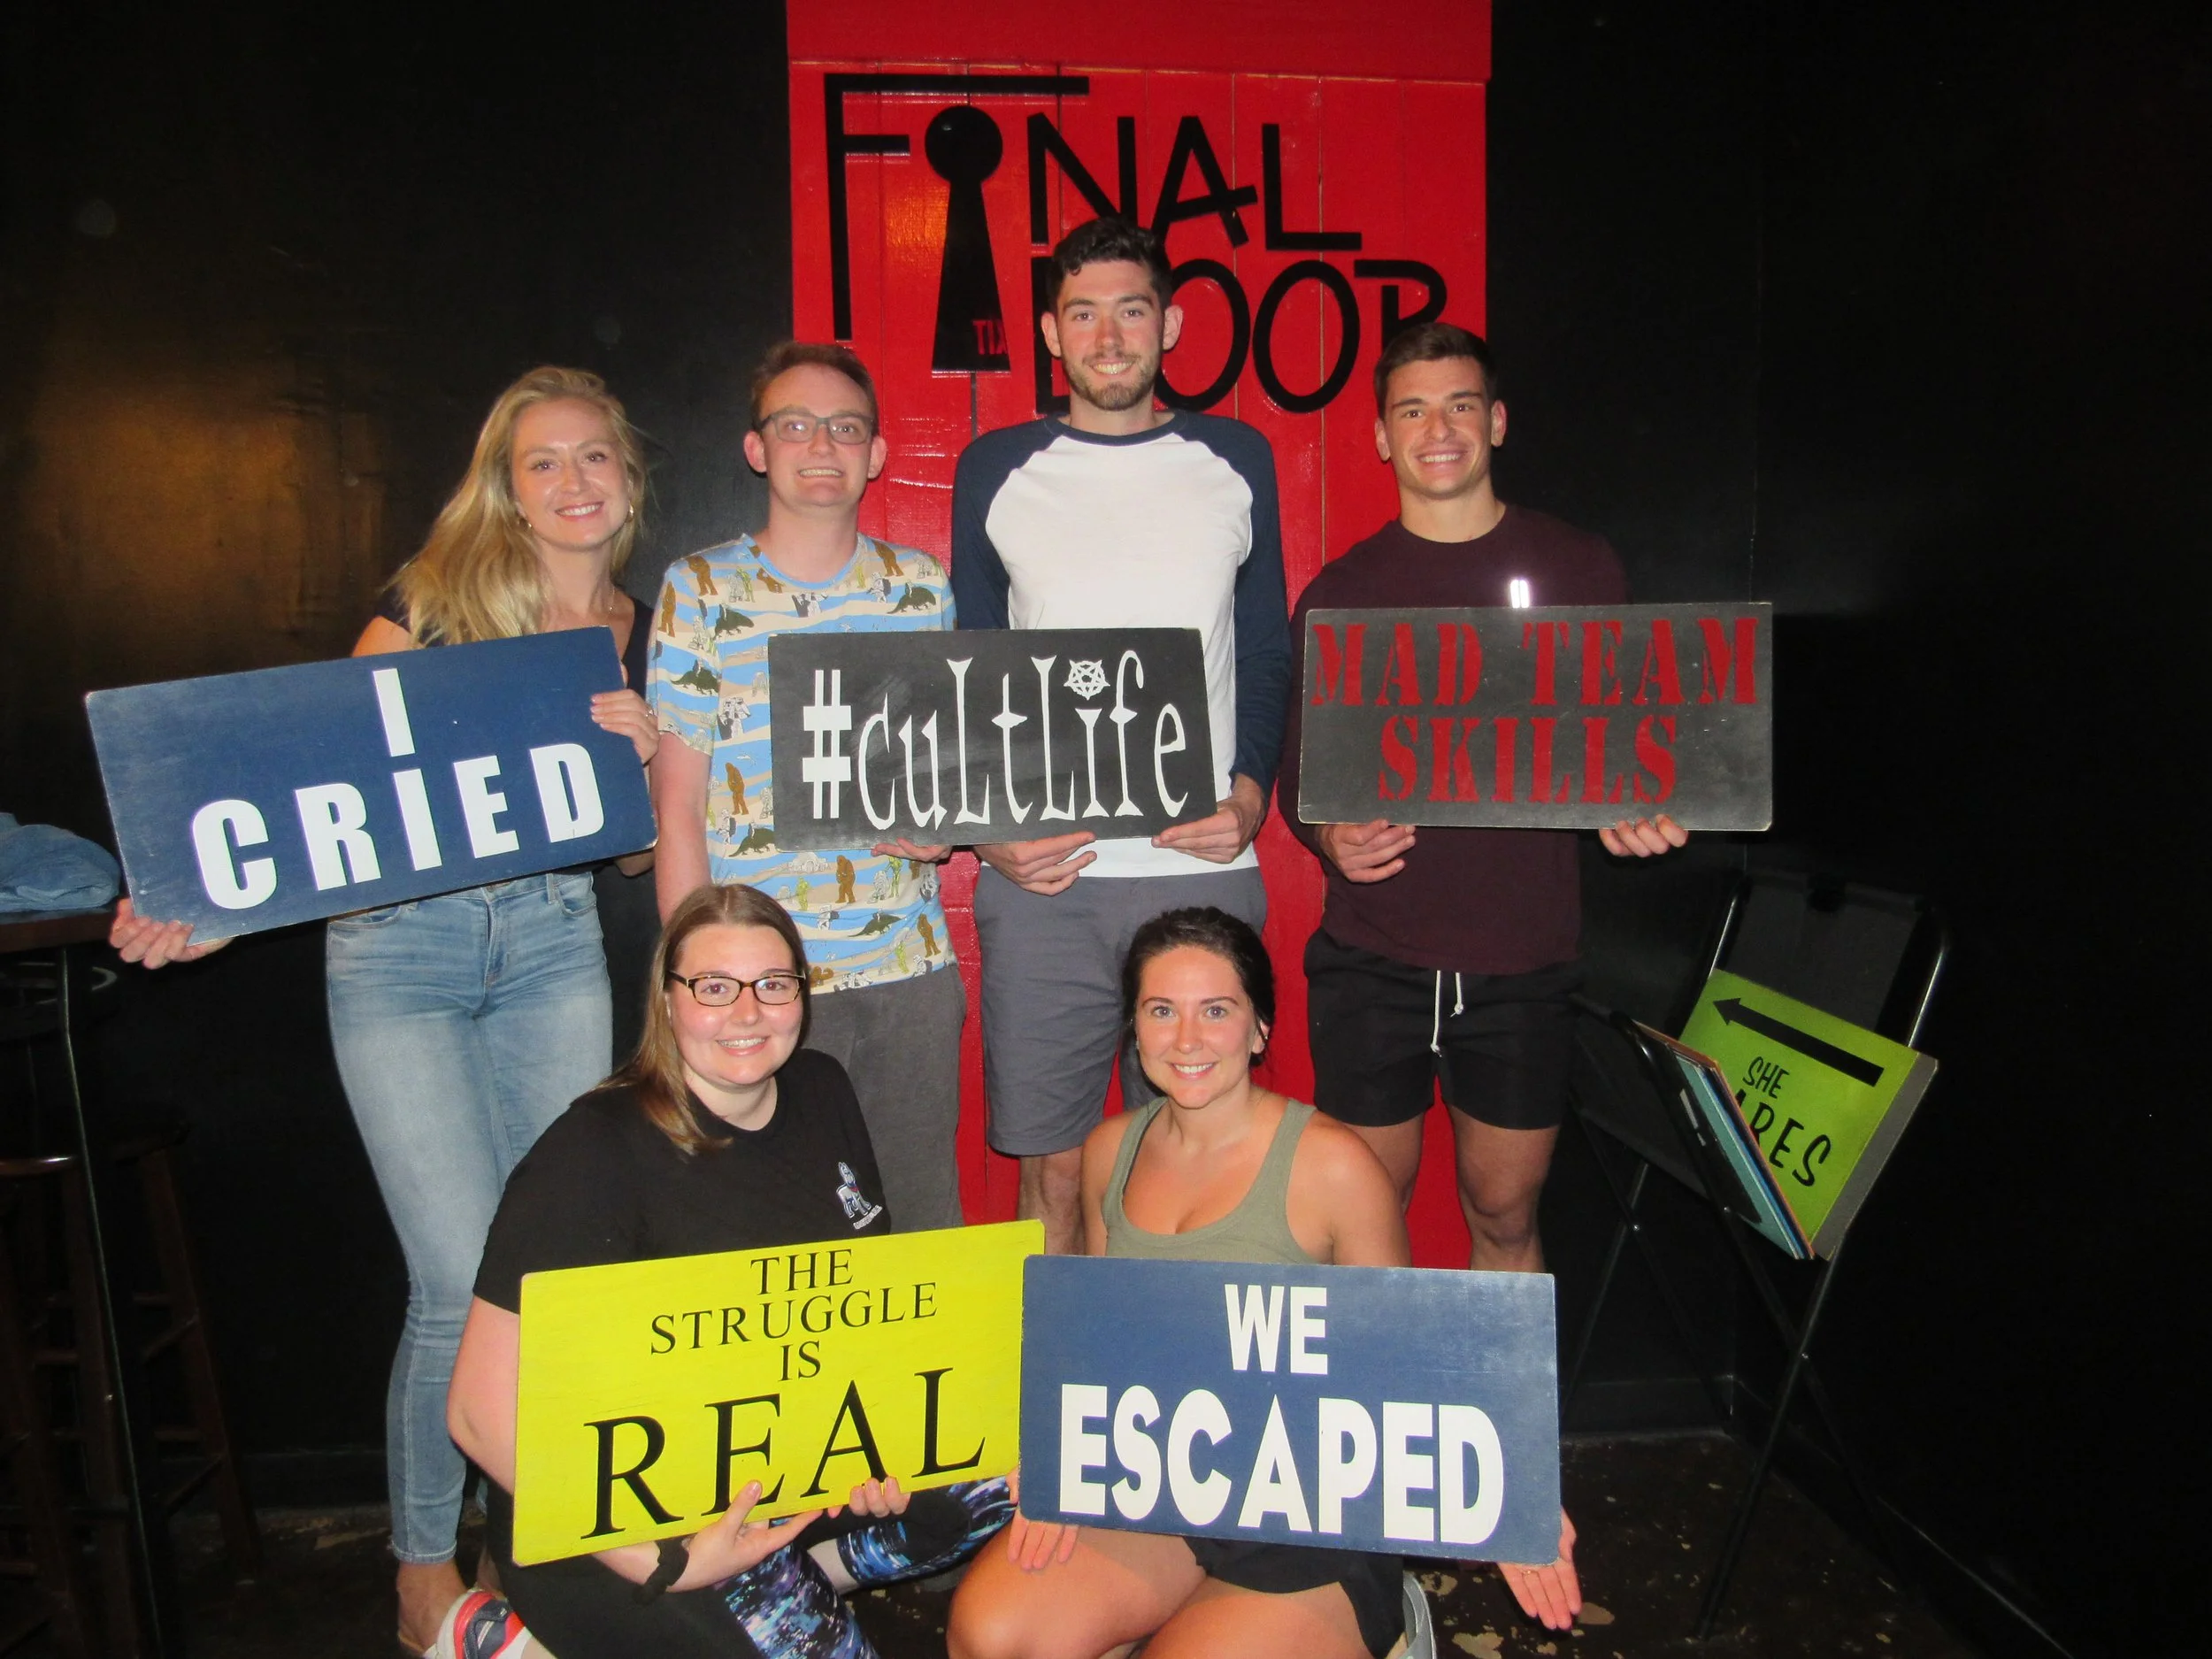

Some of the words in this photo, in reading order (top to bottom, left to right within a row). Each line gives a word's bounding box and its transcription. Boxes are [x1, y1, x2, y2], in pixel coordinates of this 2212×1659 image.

[1310, 623, 1482, 706] MAD
[1522, 618, 1758, 705] TEAM
[373, 668, 415, 757] I
[1378, 714, 1678, 803] SKILLS
[191, 743, 604, 910] CRIED
[1742, 1056, 1790, 1099] SHE
[750, 1248, 853, 1295] THE
[650, 1282, 938, 1354] STRUGGLE
[778, 1340, 821, 1382] IS
[1225, 1284, 1327, 1375] WE
[580, 1367, 986, 1540] REAL
[1060, 1383, 1503, 1545] ESCAPED
